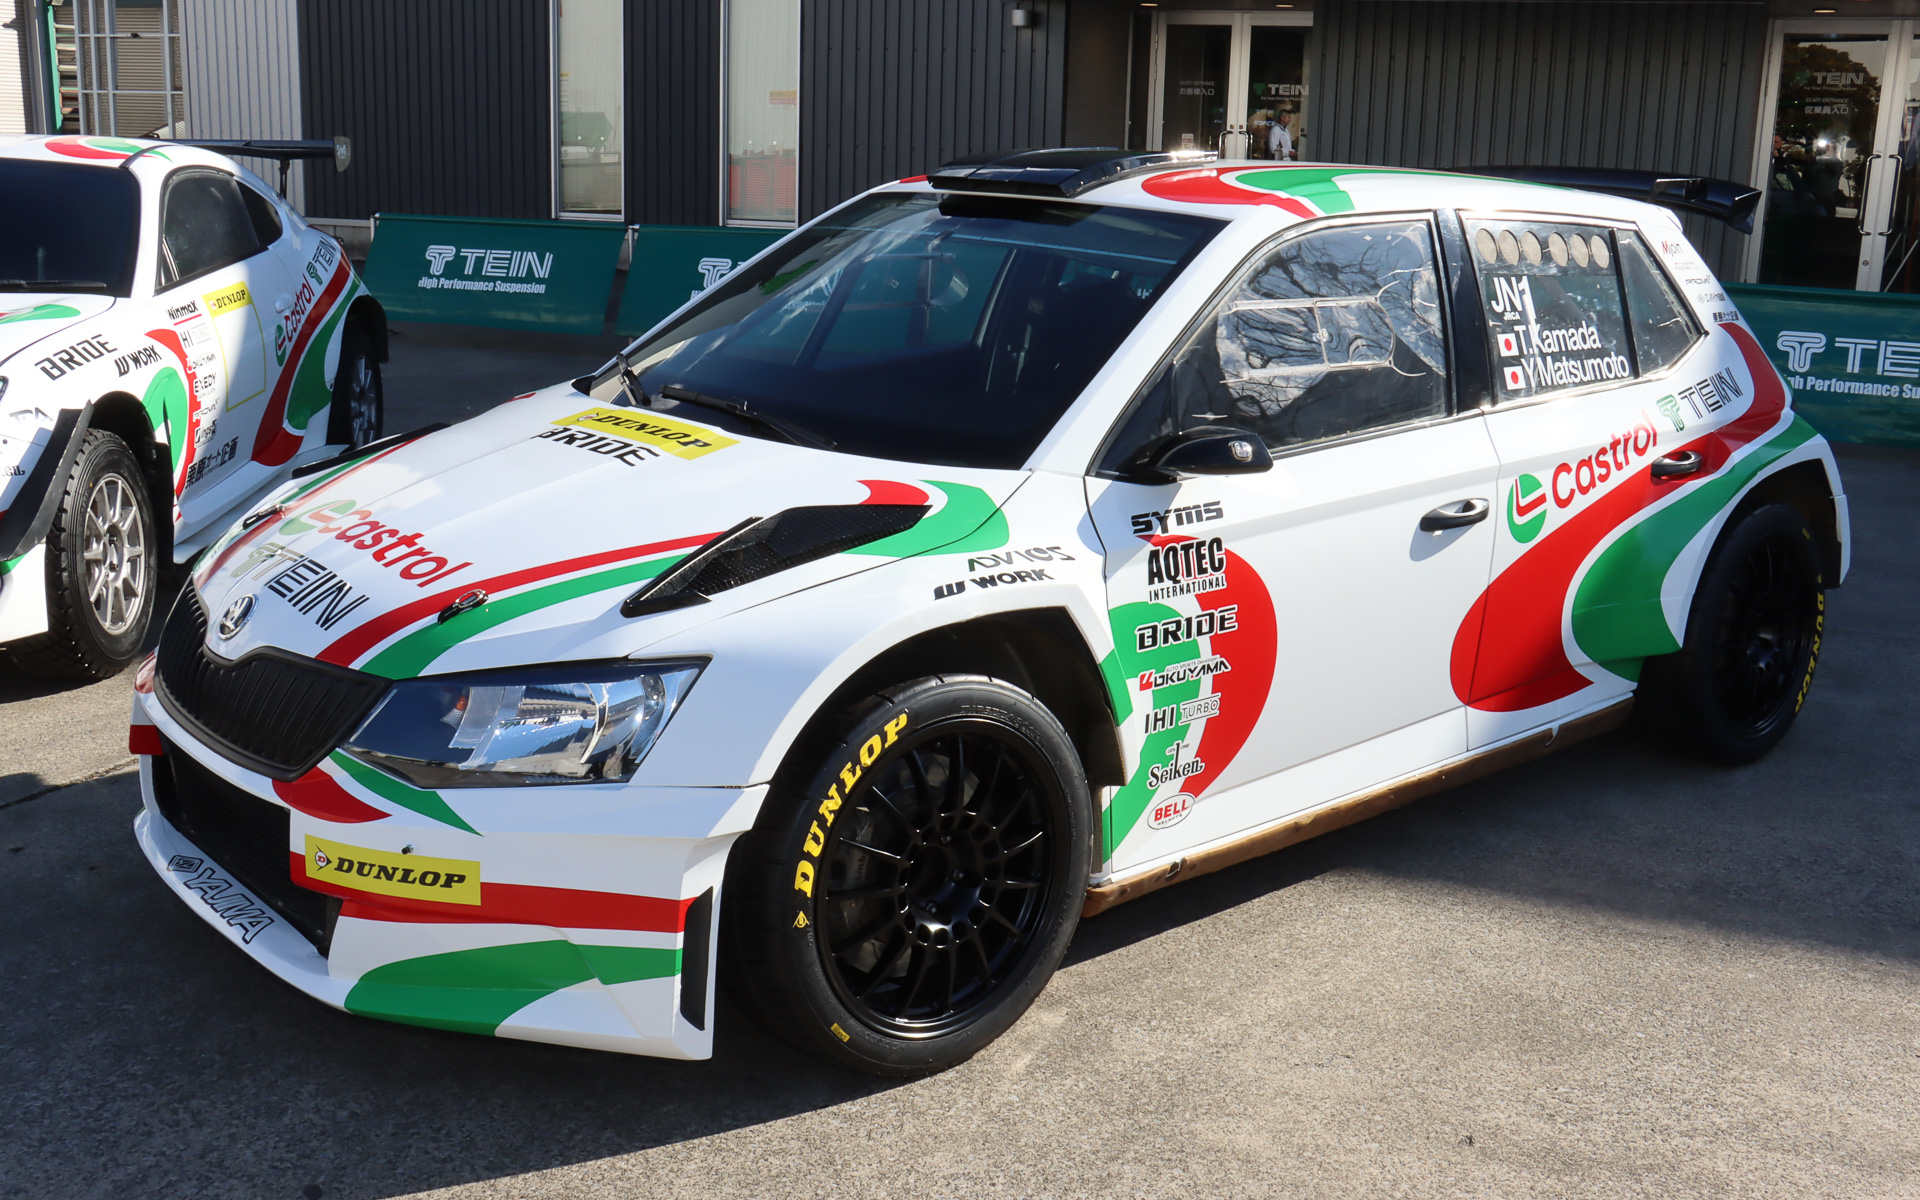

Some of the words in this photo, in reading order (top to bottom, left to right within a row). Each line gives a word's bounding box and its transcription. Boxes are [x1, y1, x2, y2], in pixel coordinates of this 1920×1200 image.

[1268, 83, 1309, 96] TEIN
[1813, 72, 1864, 85] TEIN
[313, 236, 337, 273] TEIN
[460, 248, 553, 279] TEIN
[216, 288, 246, 309] DUNLOP
[418, 276, 437, 289] High
[438, 277, 493, 291] Performance
[494, 280, 546, 294] Suspension
[1491, 275, 1536, 319] JN1
[284, 273, 315, 343] Castrol
[1503, 311, 1520, 320] JRCA
[1513, 321, 1601, 355] T.Kamada
[34, 334, 118, 381] BRIDE
[127, 345, 162, 370] WORK
[194, 372, 216, 393] EXEDY
[1678, 366, 1744, 419] TEIN
[1806, 376, 1900, 398] Performance
[530, 426, 660, 467] BRIDE
[592, 414, 712, 449] DUNLOP
[1552, 408, 1657, 509] Castrol
[1130, 500, 1224, 534] SYMS
[317, 509, 474, 588] Castrol
[1148, 537, 1225, 585] AQTEC
[250, 547, 370, 631] TEIN
[969, 569, 1055, 589] WORK
[1149, 575, 1225, 602] INTERNATIONAL
[1137, 607, 1238, 650] BRIDE
[1180, 661, 1196, 669] SPORTS
[1197, 656, 1219, 666] Developer
[1795, 592, 1824, 713] DUNLOP
[1154, 660, 1229, 688] OKUYAMA
[1145, 706, 1175, 734] IHI
[1182, 699, 1219, 719] TURBO
[1148, 742, 1203, 788] Seiken
[794, 713, 908, 898] DUNLOP
[1154, 799, 1189, 822] BELL
[334, 856, 466, 889] DUNLOP
